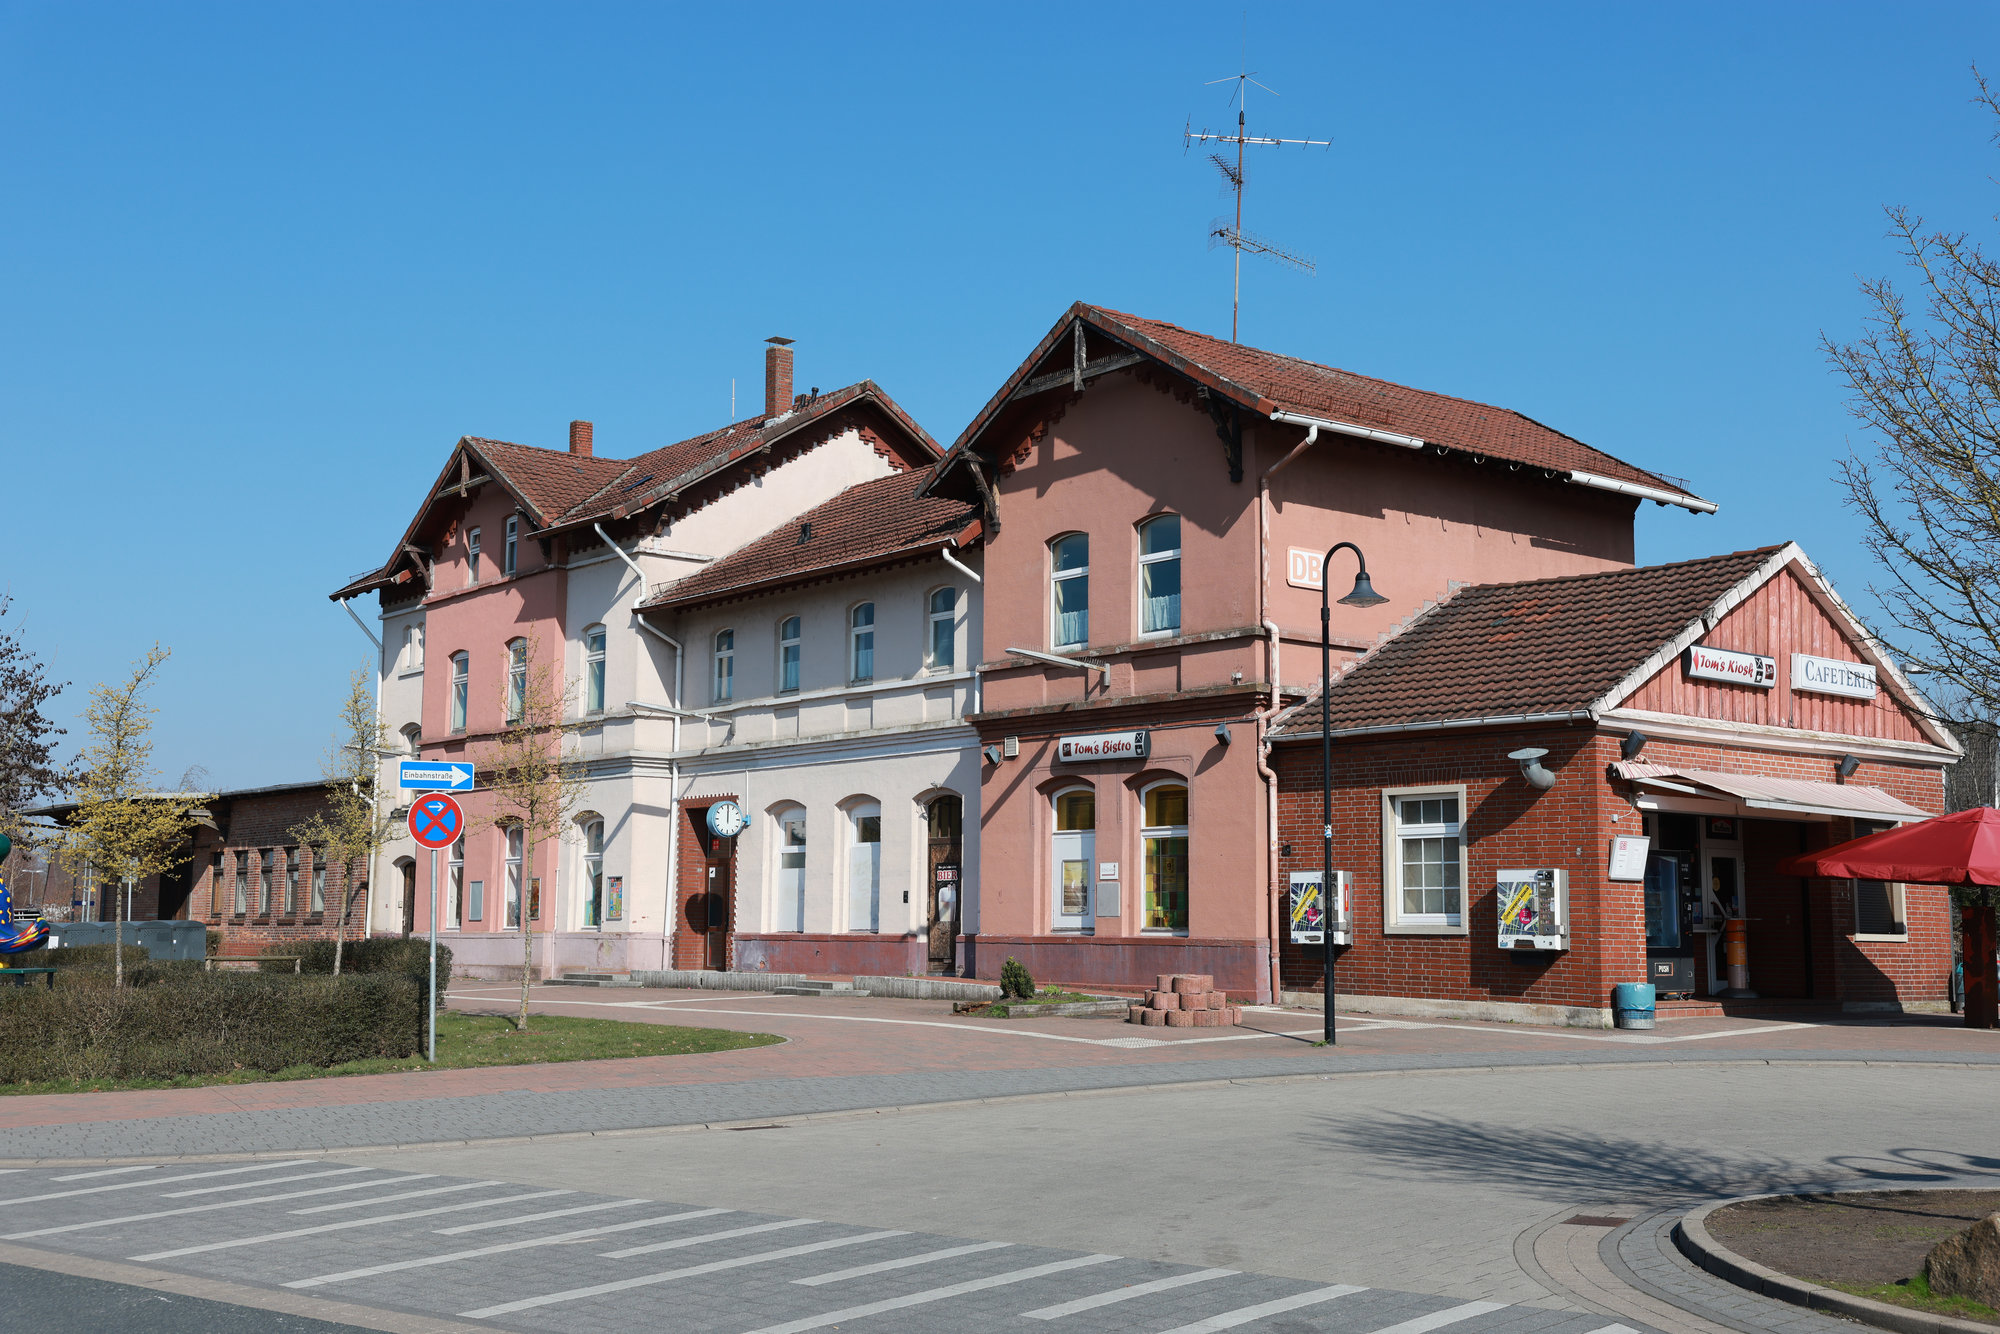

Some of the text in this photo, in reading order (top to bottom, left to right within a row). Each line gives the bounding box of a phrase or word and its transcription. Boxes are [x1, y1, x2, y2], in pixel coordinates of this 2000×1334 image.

[1292, 552, 1322, 582] DB
[1700, 654, 1754, 678] Tom's Kiosk
[1805, 659, 1874, 690] CAFETERIA
[1074, 739, 1132, 755] Tom's Bistro
[403, 771, 453, 780] Einbahnstraße
[936, 870, 958, 881] BIER
[1658, 965, 1670, 973] PUSH
